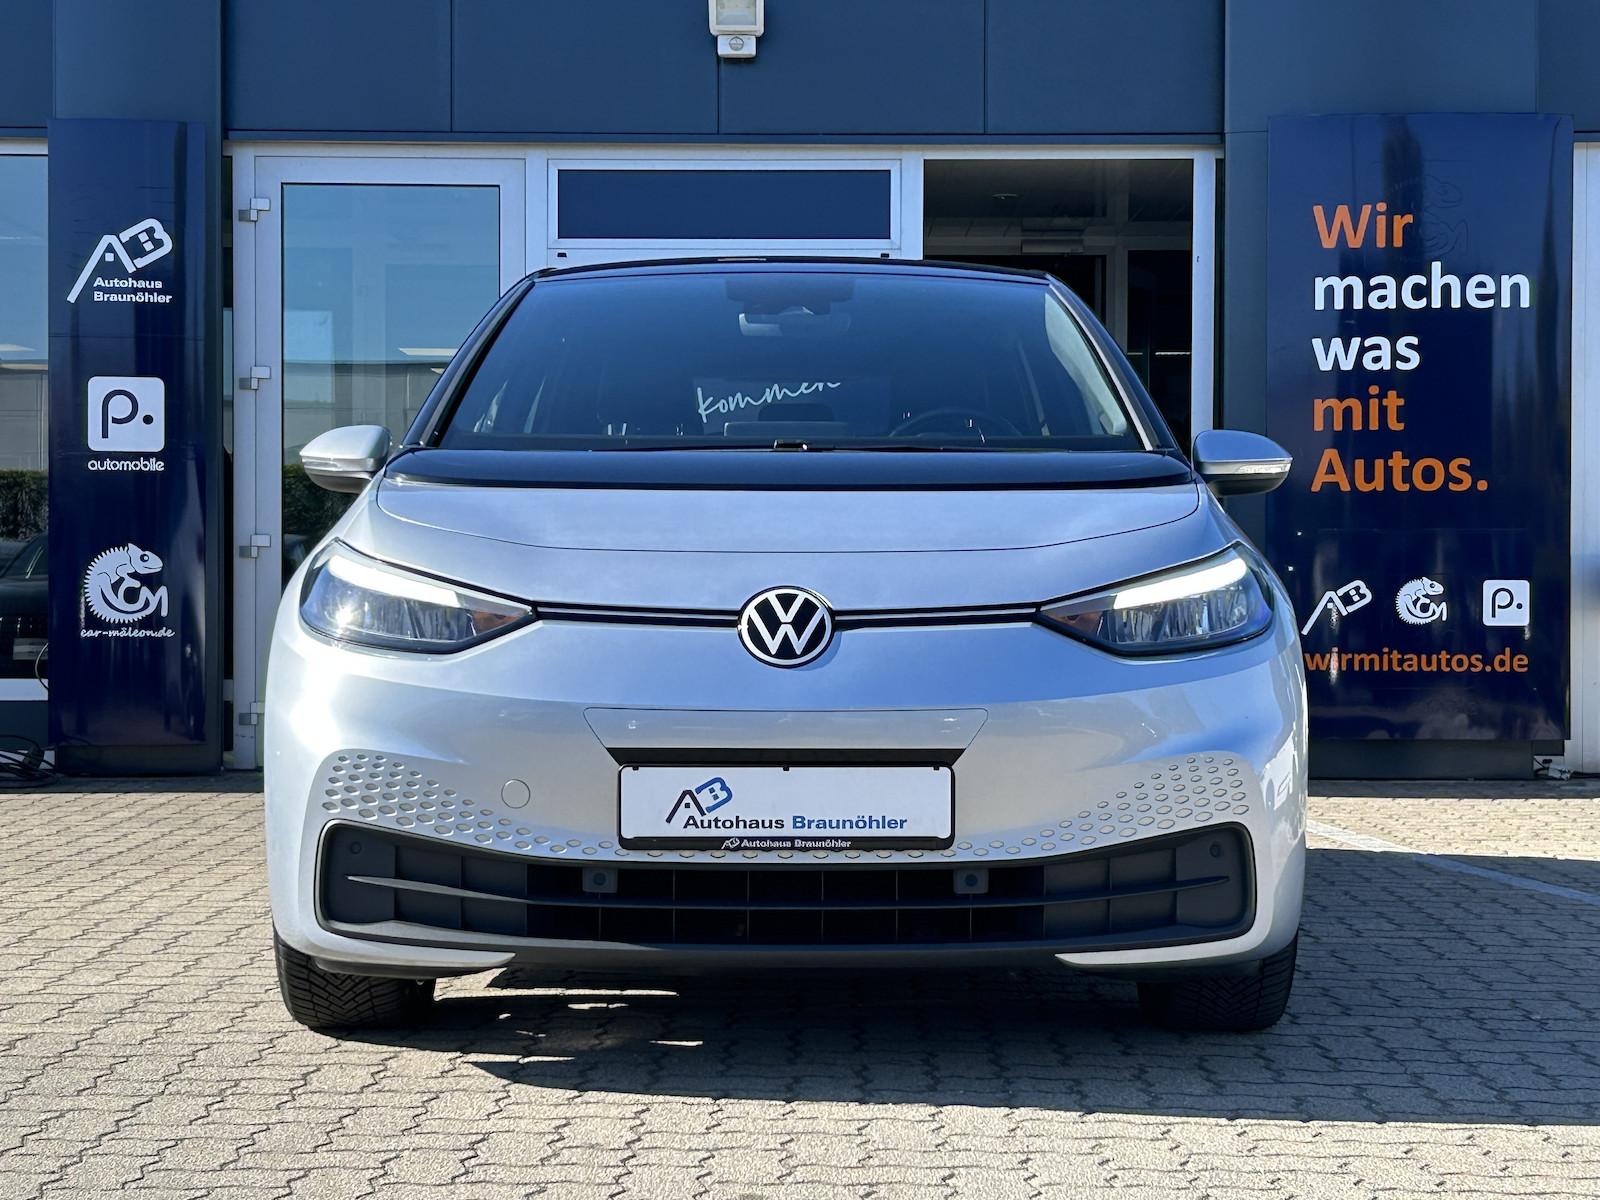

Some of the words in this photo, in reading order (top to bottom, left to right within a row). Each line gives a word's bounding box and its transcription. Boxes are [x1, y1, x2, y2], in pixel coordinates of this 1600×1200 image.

[1312, 202, 1414, 249] Wir
[93, 277, 163, 289] Autohaus
[1314, 261, 1530, 310] machen
[93, 291, 173, 303] Braunöhler
[1311, 335, 1421, 371] was
[1313, 385, 1405, 432] mit
[87, 457, 165, 471] automobile
[1310, 448, 1489, 493] Autos.
[1304, 647, 1529, 673] wirmitautos.de
[683, 815, 785, 830] Autohaus
[792, 815, 908, 830] Braunöhler
[741, 839, 792, 849] Autohaus
[794, 839, 852, 849] Braunöhler
